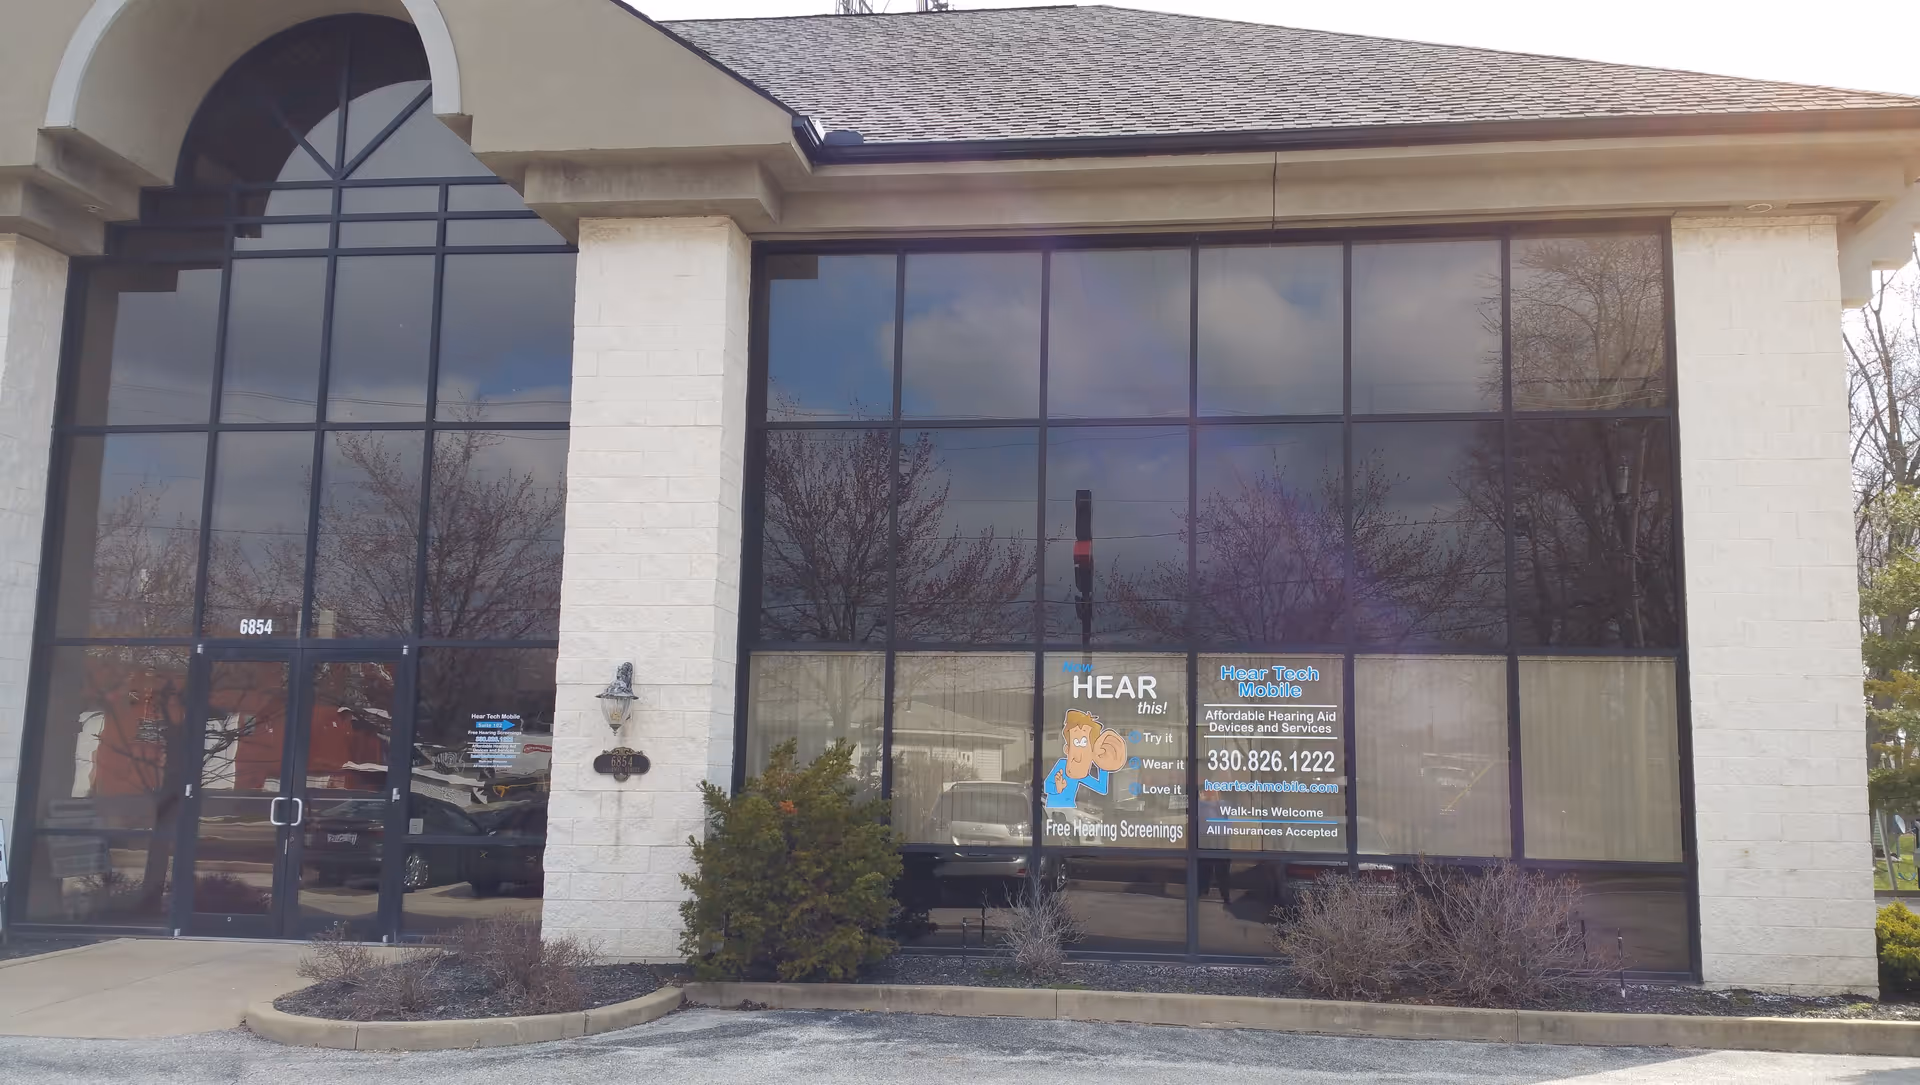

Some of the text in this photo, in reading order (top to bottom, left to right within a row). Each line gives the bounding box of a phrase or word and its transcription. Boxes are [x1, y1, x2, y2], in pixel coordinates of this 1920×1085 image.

[240, 618, 272, 635] 6854
[1062, 661, 1093, 673] Now
[1220, 665, 1320, 681] Hear Tech
[1073, 675, 1157, 699] HEAR
[1238, 681, 1302, 698] Mobile
[1137, 701, 1168, 715] this!
[1205, 710, 1337, 724] Affordable Hearing Aid
[1209, 722, 1332, 734] Devices and Services
[1143, 732, 1174, 745] Try it
[611, 756, 633, 767] 6854
[1142, 758, 1185, 770] Wear it
[1207, 749, 1336, 773] 330.826.1222
[1142, 783, 1182, 795] Love it
[1204, 779, 1339, 793] heartechmobile.com
[1219, 806, 1324, 818] Walk-Ins Welcome
[1046, 818, 1184, 843] Free Hearing Screenings
[1206, 825, 1339, 839] All Insurances Accepted
